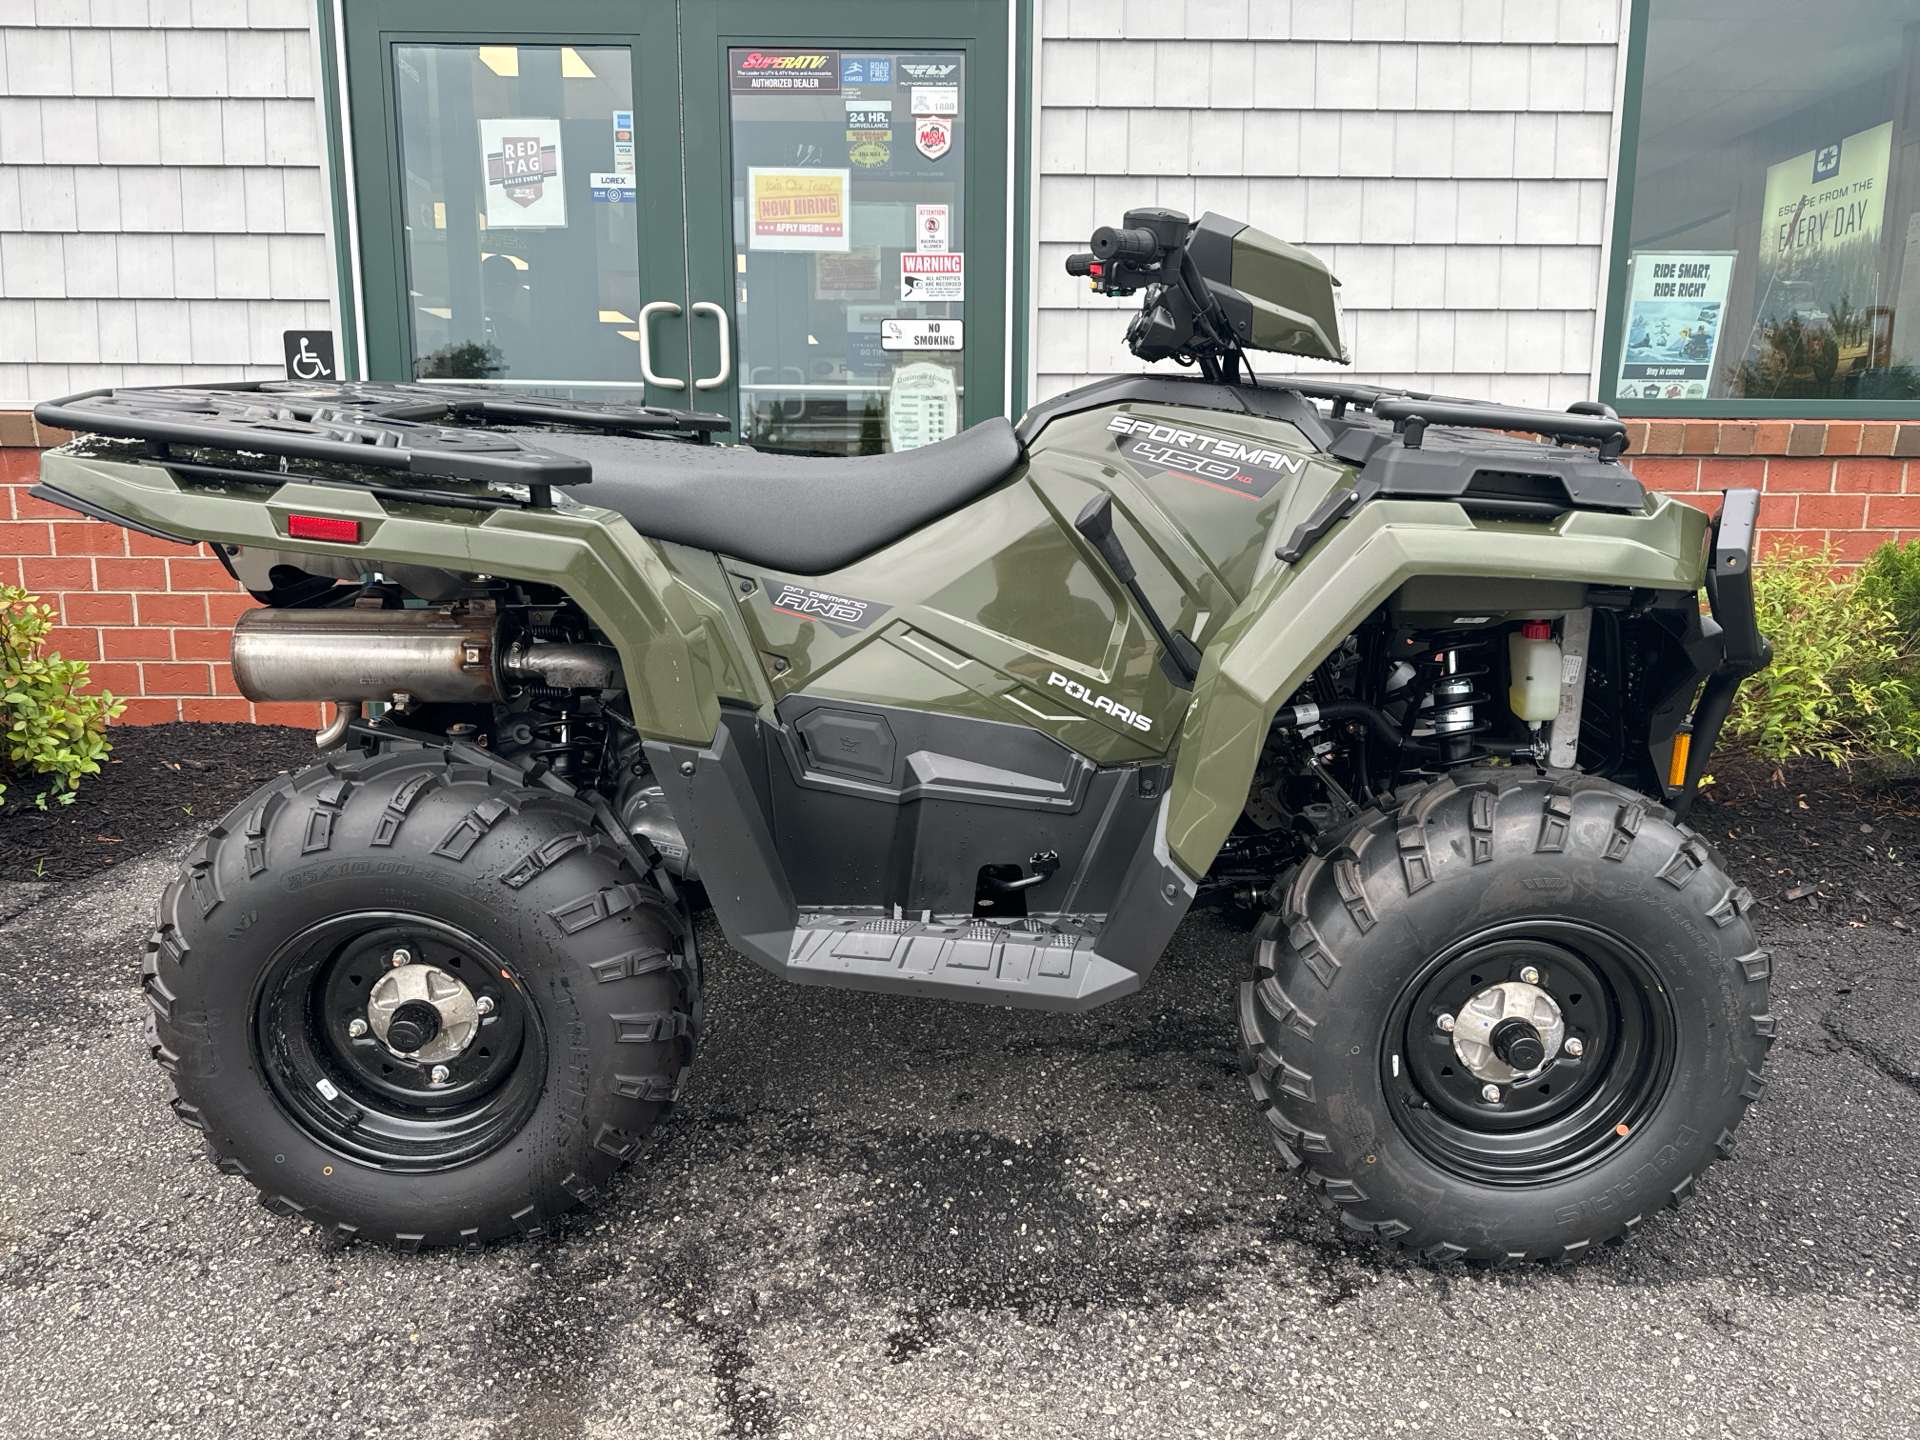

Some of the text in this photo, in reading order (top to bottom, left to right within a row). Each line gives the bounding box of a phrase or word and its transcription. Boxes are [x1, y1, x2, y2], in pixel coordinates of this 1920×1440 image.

[870, 61, 889, 70] ROAD
[900, 64, 957, 75] FLY
[751, 78, 819, 88] AUTHORIZED DEALER
[934, 102, 955, 111] 1880
[849, 112, 889, 122] 24 HR.
[919, 130, 946, 145] MSA
[504, 141, 538, 159] RED
[506, 157, 540, 175] TAG
[504, 174, 542, 186] SALES EVENT
[601, 176, 626, 184] LOREX
[765, 178, 834, 192] Join Our Team!
[1778, 178, 1874, 217] ESCPE FROM THE
[761, 197, 837, 217] NOW HIRING
[1833, 199, 1868, 237] DAY
[776, 223, 823, 233] APPLY INSIDE
[905, 256, 960, 272] WARNING
[1653, 263, 1711, 281] RIDE SMART,
[1653, 282, 1707, 297] RIDE RIGHT
[928, 323, 941, 333] NO
[913, 335, 955, 346] SMOKING
[860, 348, 871, 356] GO
[1646, 366, 1686, 377] Stay in control
[897, 374, 951, 385] Business Hours
[1106, 416, 1304, 474] SPORTSMAN
[1133, 442, 1241, 481] 450
[783, 585, 868, 609] ON DEMAND
[774, 591, 865, 623] AWD
[1047, 670, 1153, 732] POLARIS
[286, 859, 457, 892] 25X10.00-12
[1552, 1123, 1700, 1227] POLARIS
